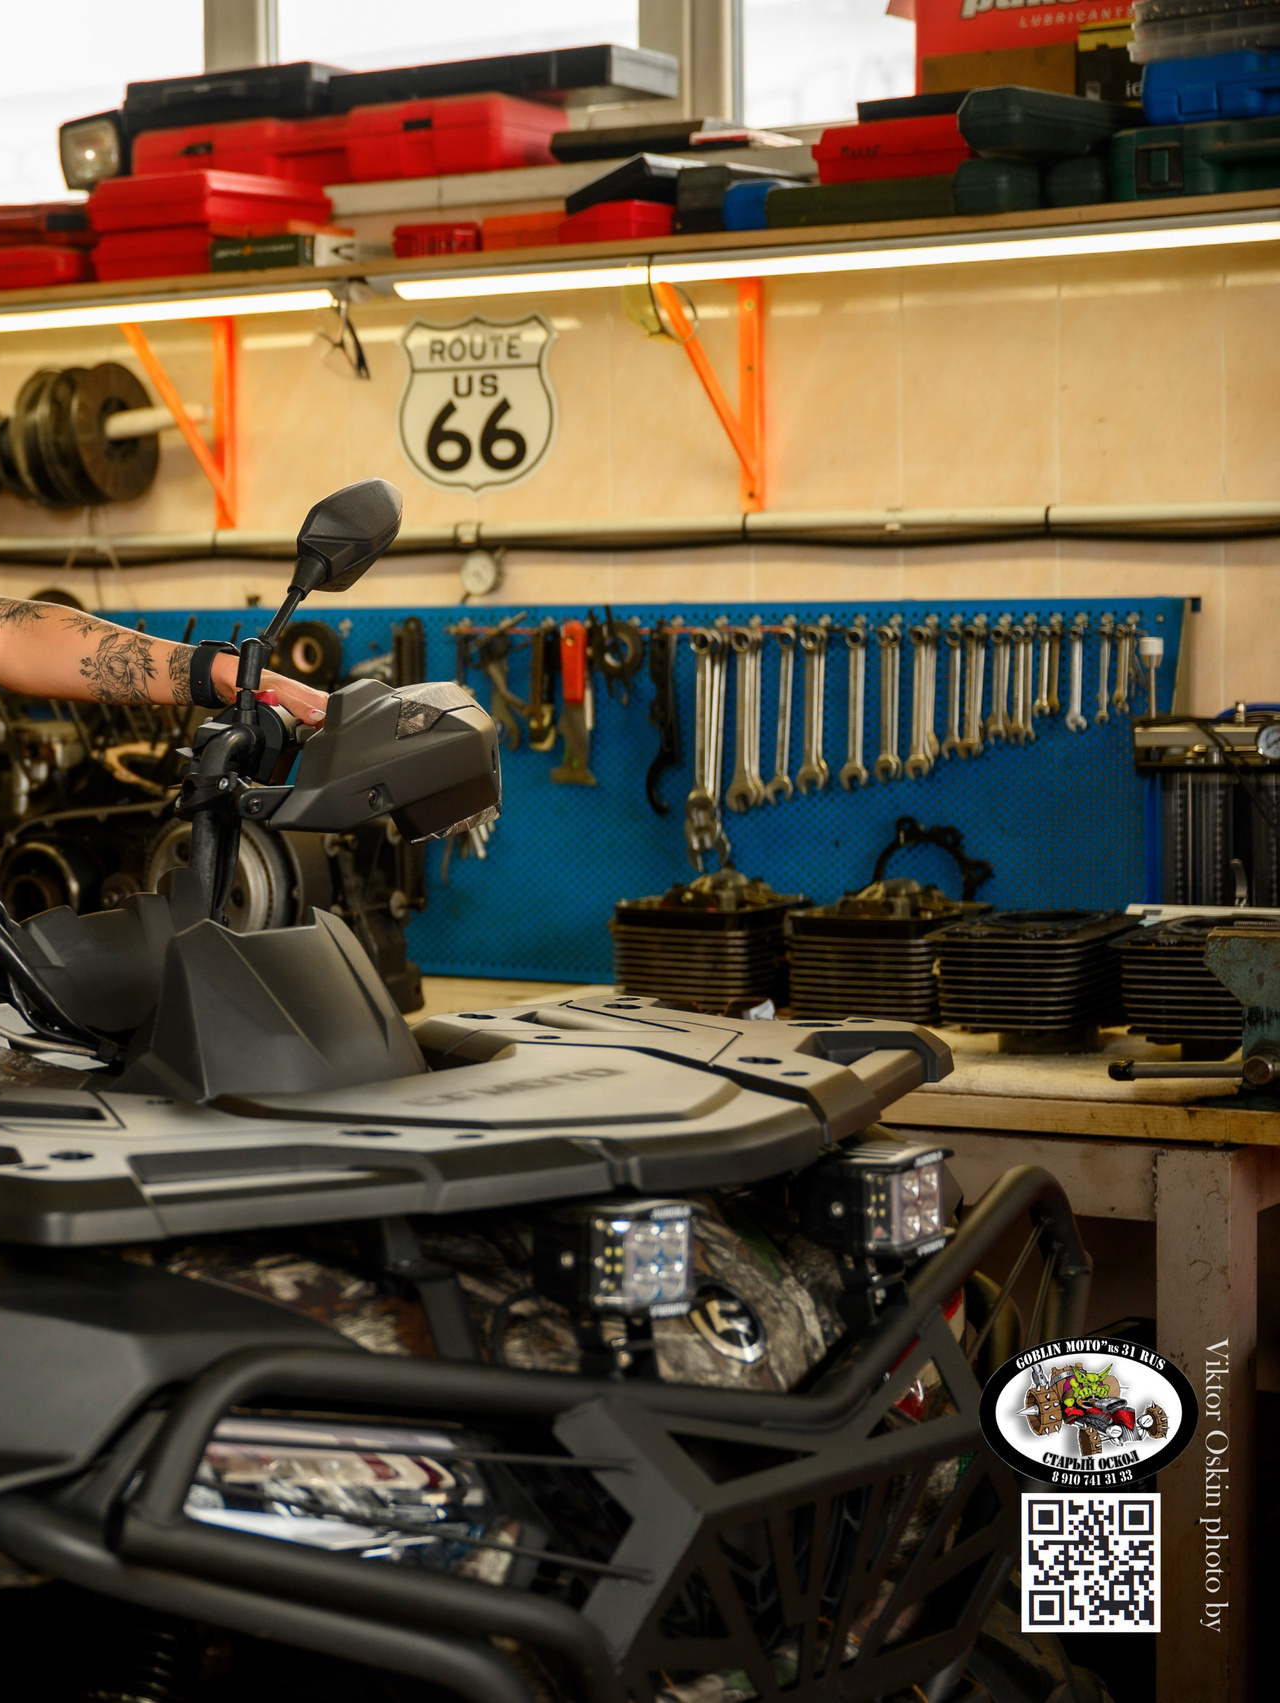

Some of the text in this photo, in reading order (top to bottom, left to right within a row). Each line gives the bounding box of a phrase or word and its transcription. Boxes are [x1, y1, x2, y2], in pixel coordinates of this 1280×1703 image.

[429, 335, 522, 362] ROUTE
[453, 373, 499, 398] US
[426, 398, 527, 472] 66
